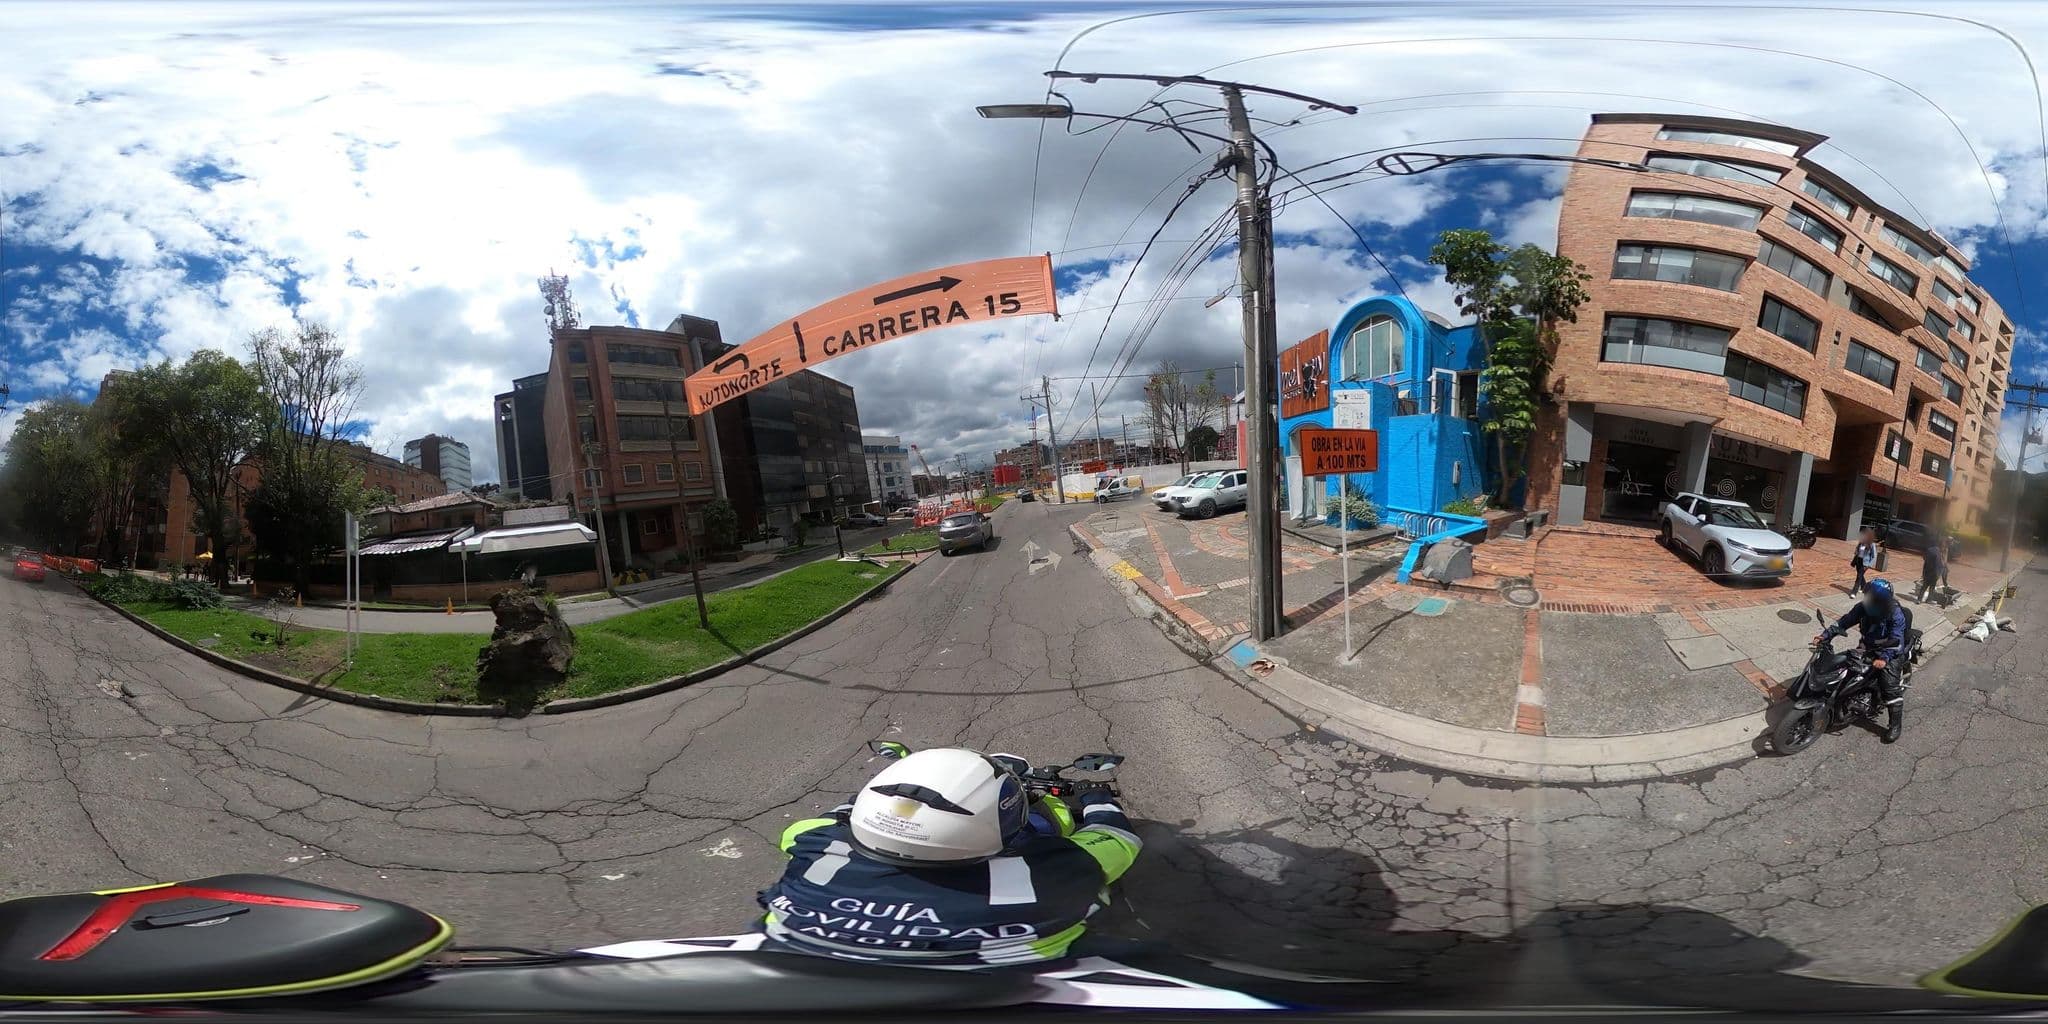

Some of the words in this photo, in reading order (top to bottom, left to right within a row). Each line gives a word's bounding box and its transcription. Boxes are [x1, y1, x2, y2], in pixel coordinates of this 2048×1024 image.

[823, 300, 970, 357] CARRERA
[984, 292, 1022, 316] 15
[699, 357, 783, 410] AUTONORTE
[1312, 437, 1331, 452] OBRA
[1333, 436, 1343, 451] EN
[1345, 437, 1354, 451] LA
[1355, 437, 1366, 451] VIA
[1317, 455, 1324, 469] A
[1326, 454, 1344, 469] 100
[1346, 454, 1366, 468] MTS
[771, 895, 1037, 939] MOVILIDAD
[831, 897, 941, 923] GUÍA
